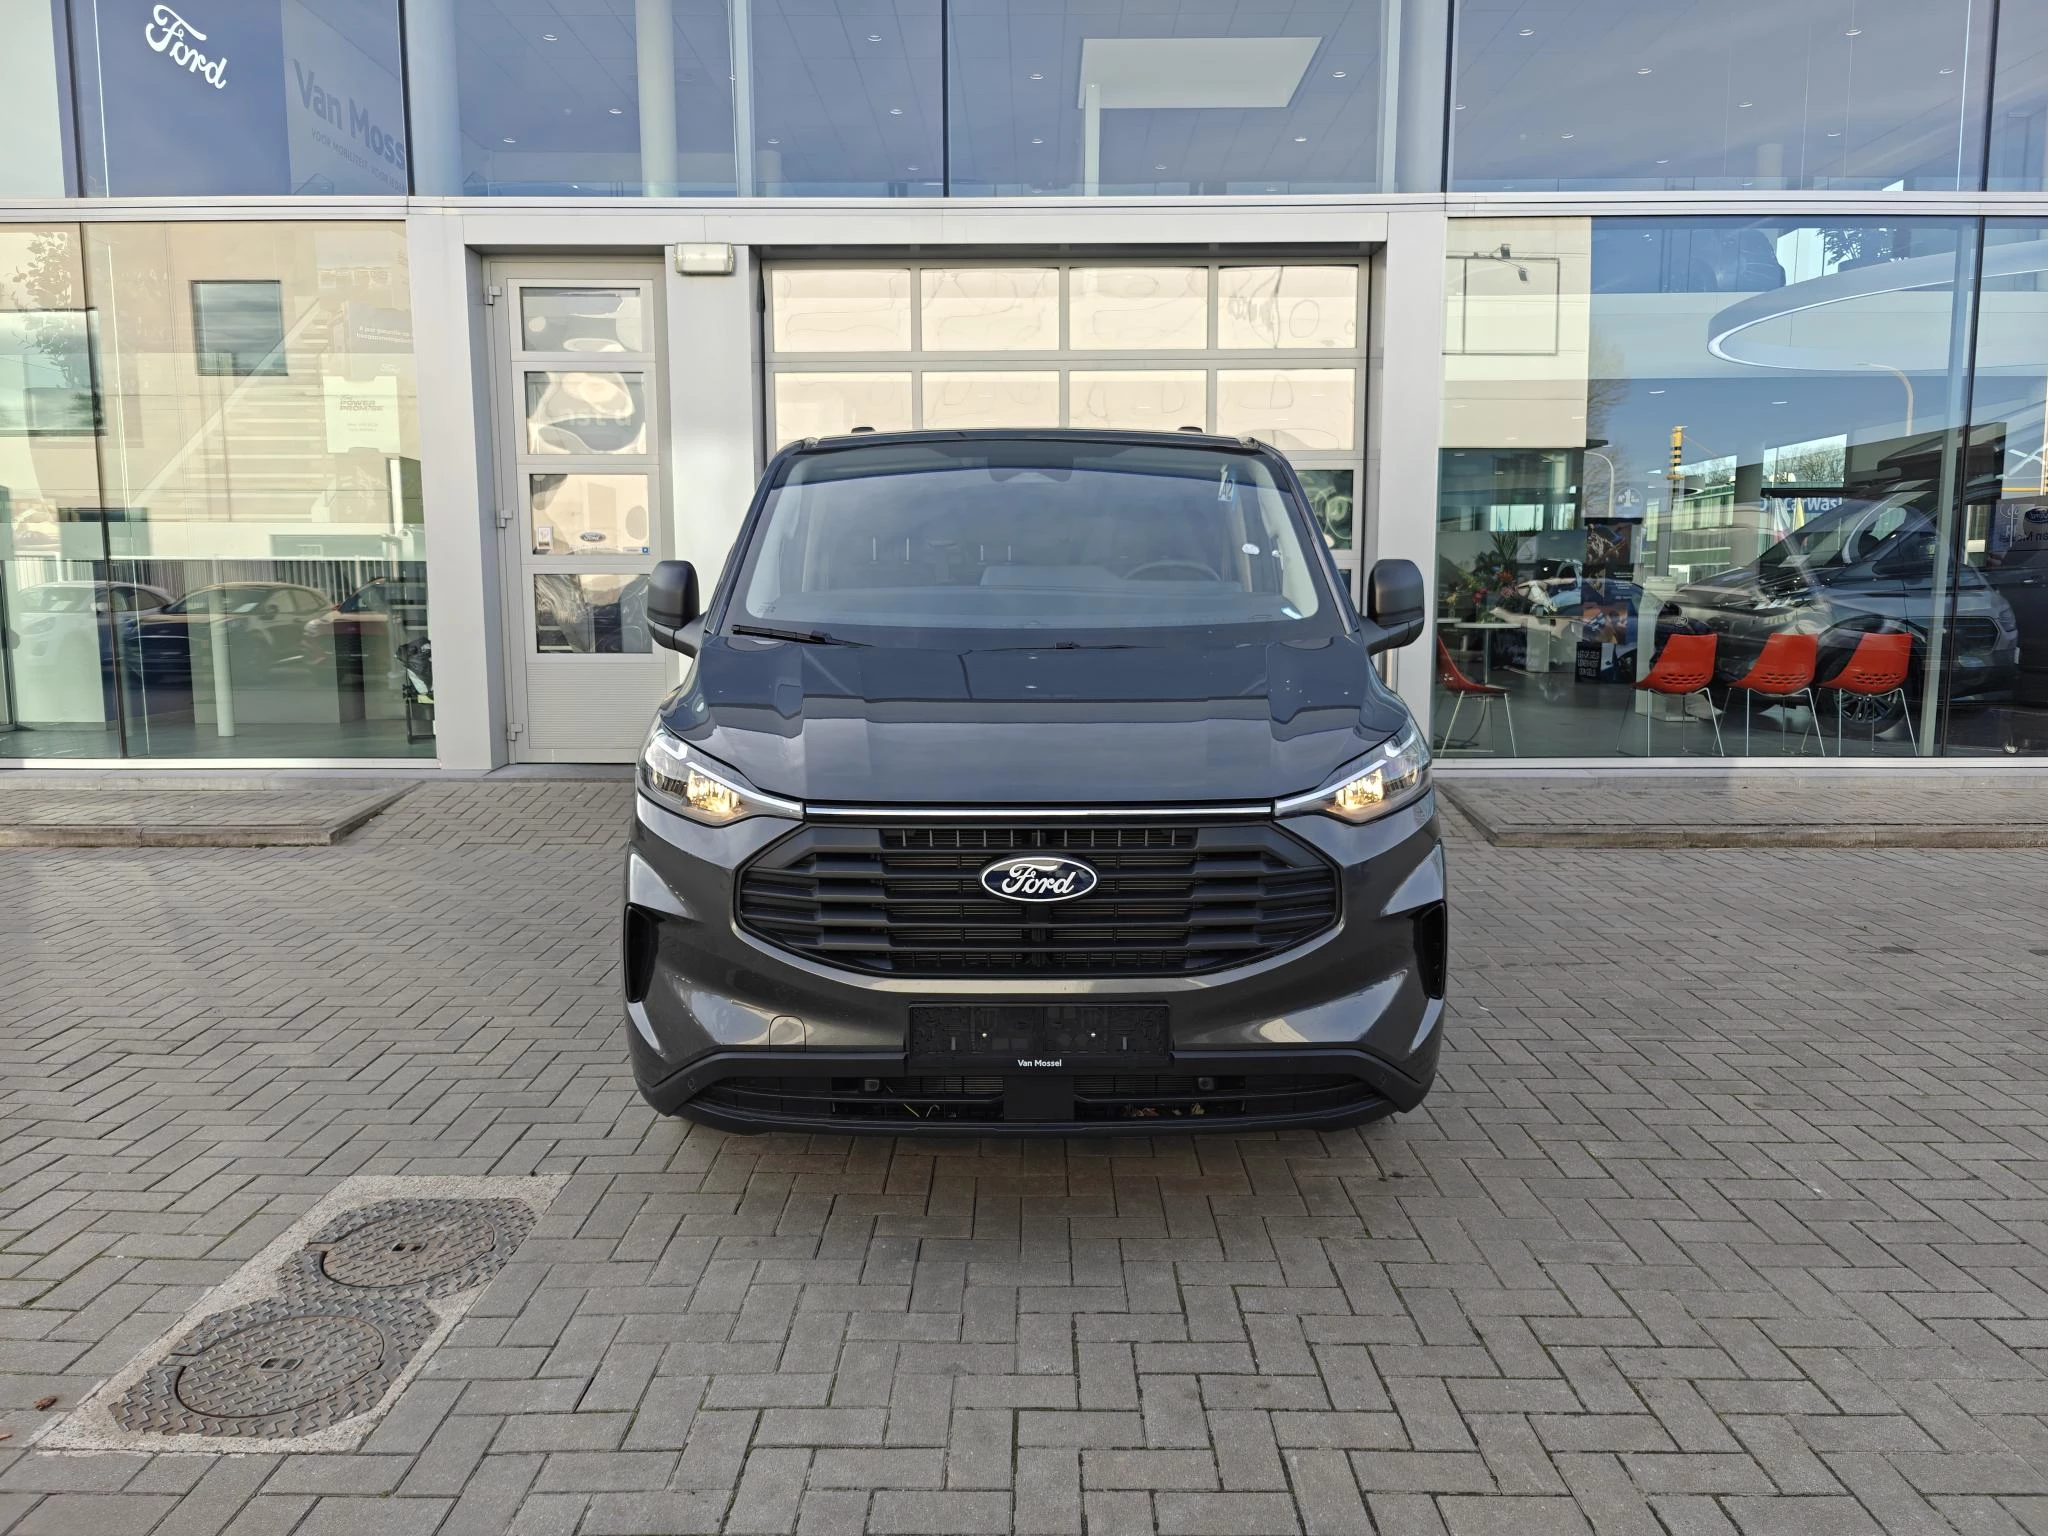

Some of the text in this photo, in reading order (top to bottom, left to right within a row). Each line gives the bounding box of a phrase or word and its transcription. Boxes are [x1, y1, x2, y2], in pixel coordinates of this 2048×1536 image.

[145, 4, 227, 89] Ford
[293, 58, 343, 130] Van
[1001, 863, 1075, 894] Ford
[1017, 1058, 1062, 1067] Van Mossel
